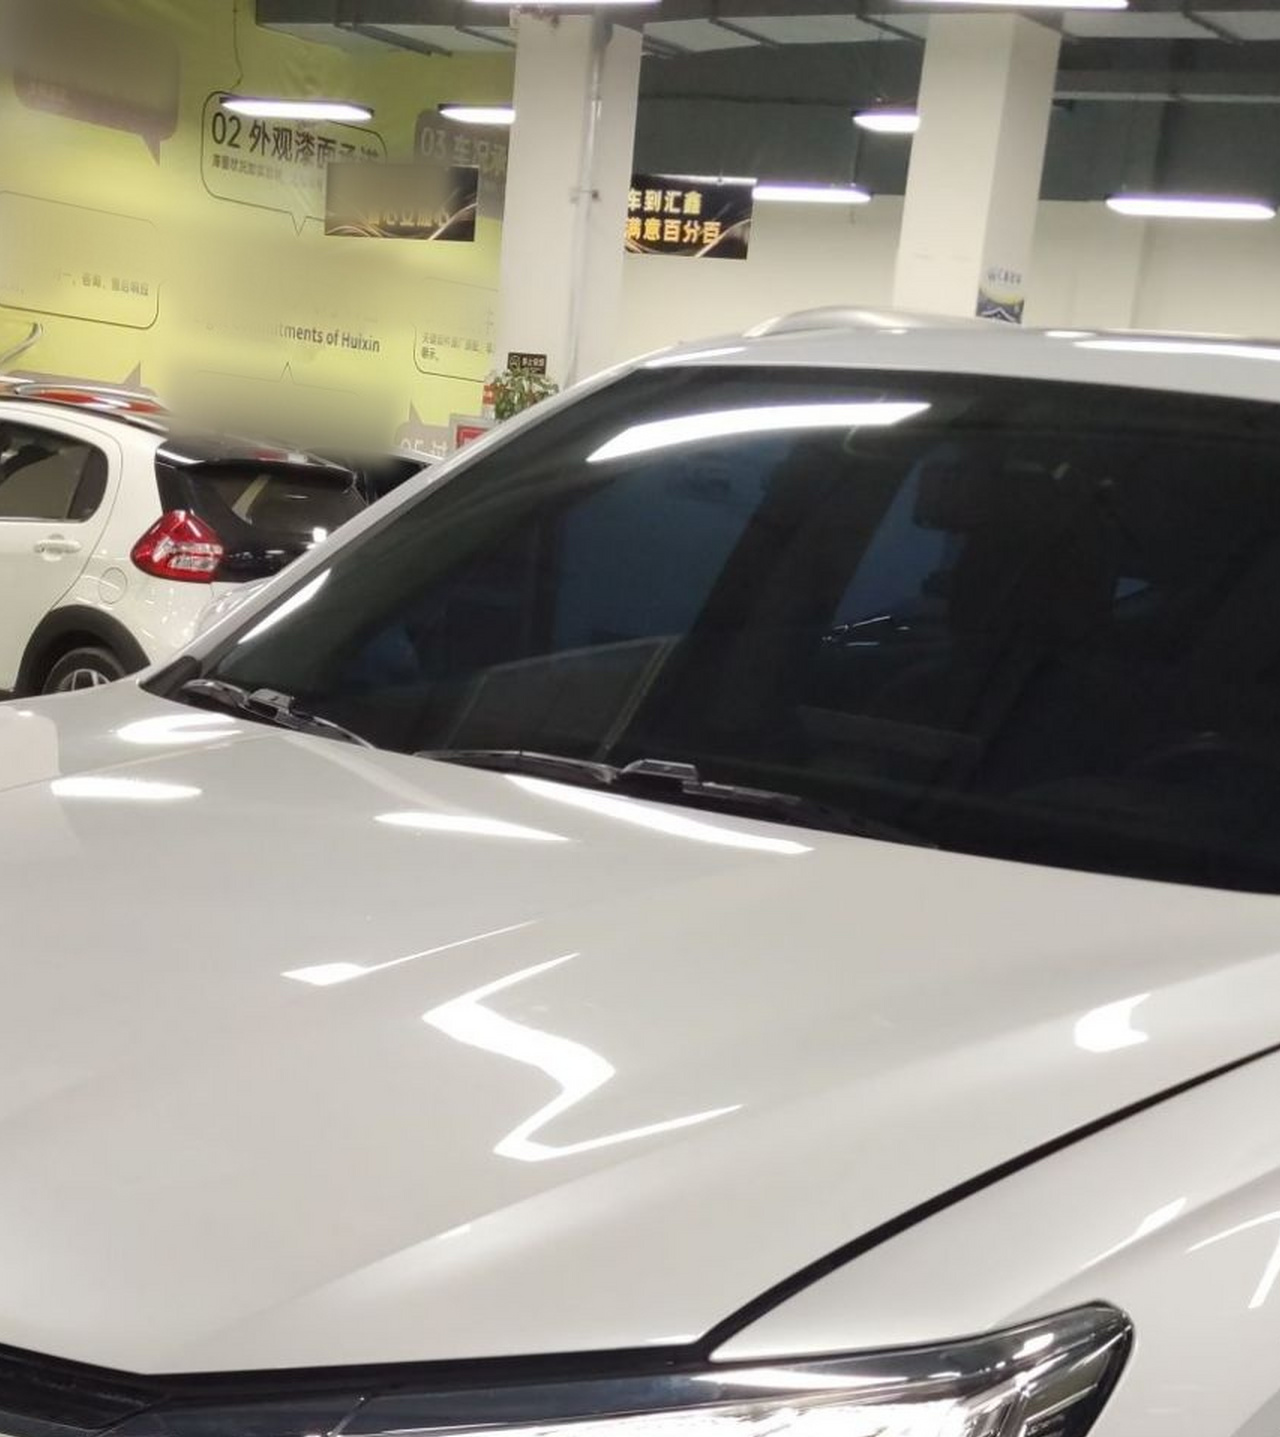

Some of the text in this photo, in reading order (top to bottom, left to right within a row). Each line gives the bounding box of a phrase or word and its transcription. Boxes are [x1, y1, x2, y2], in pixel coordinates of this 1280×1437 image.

[212, 112, 241, 149] 02
[628, 188, 702, 215] 车到汇鑫
[625, 216, 721, 244] 满意百分百
[326, 328, 339, 346] of
[341, 332, 381, 352] Huixin
